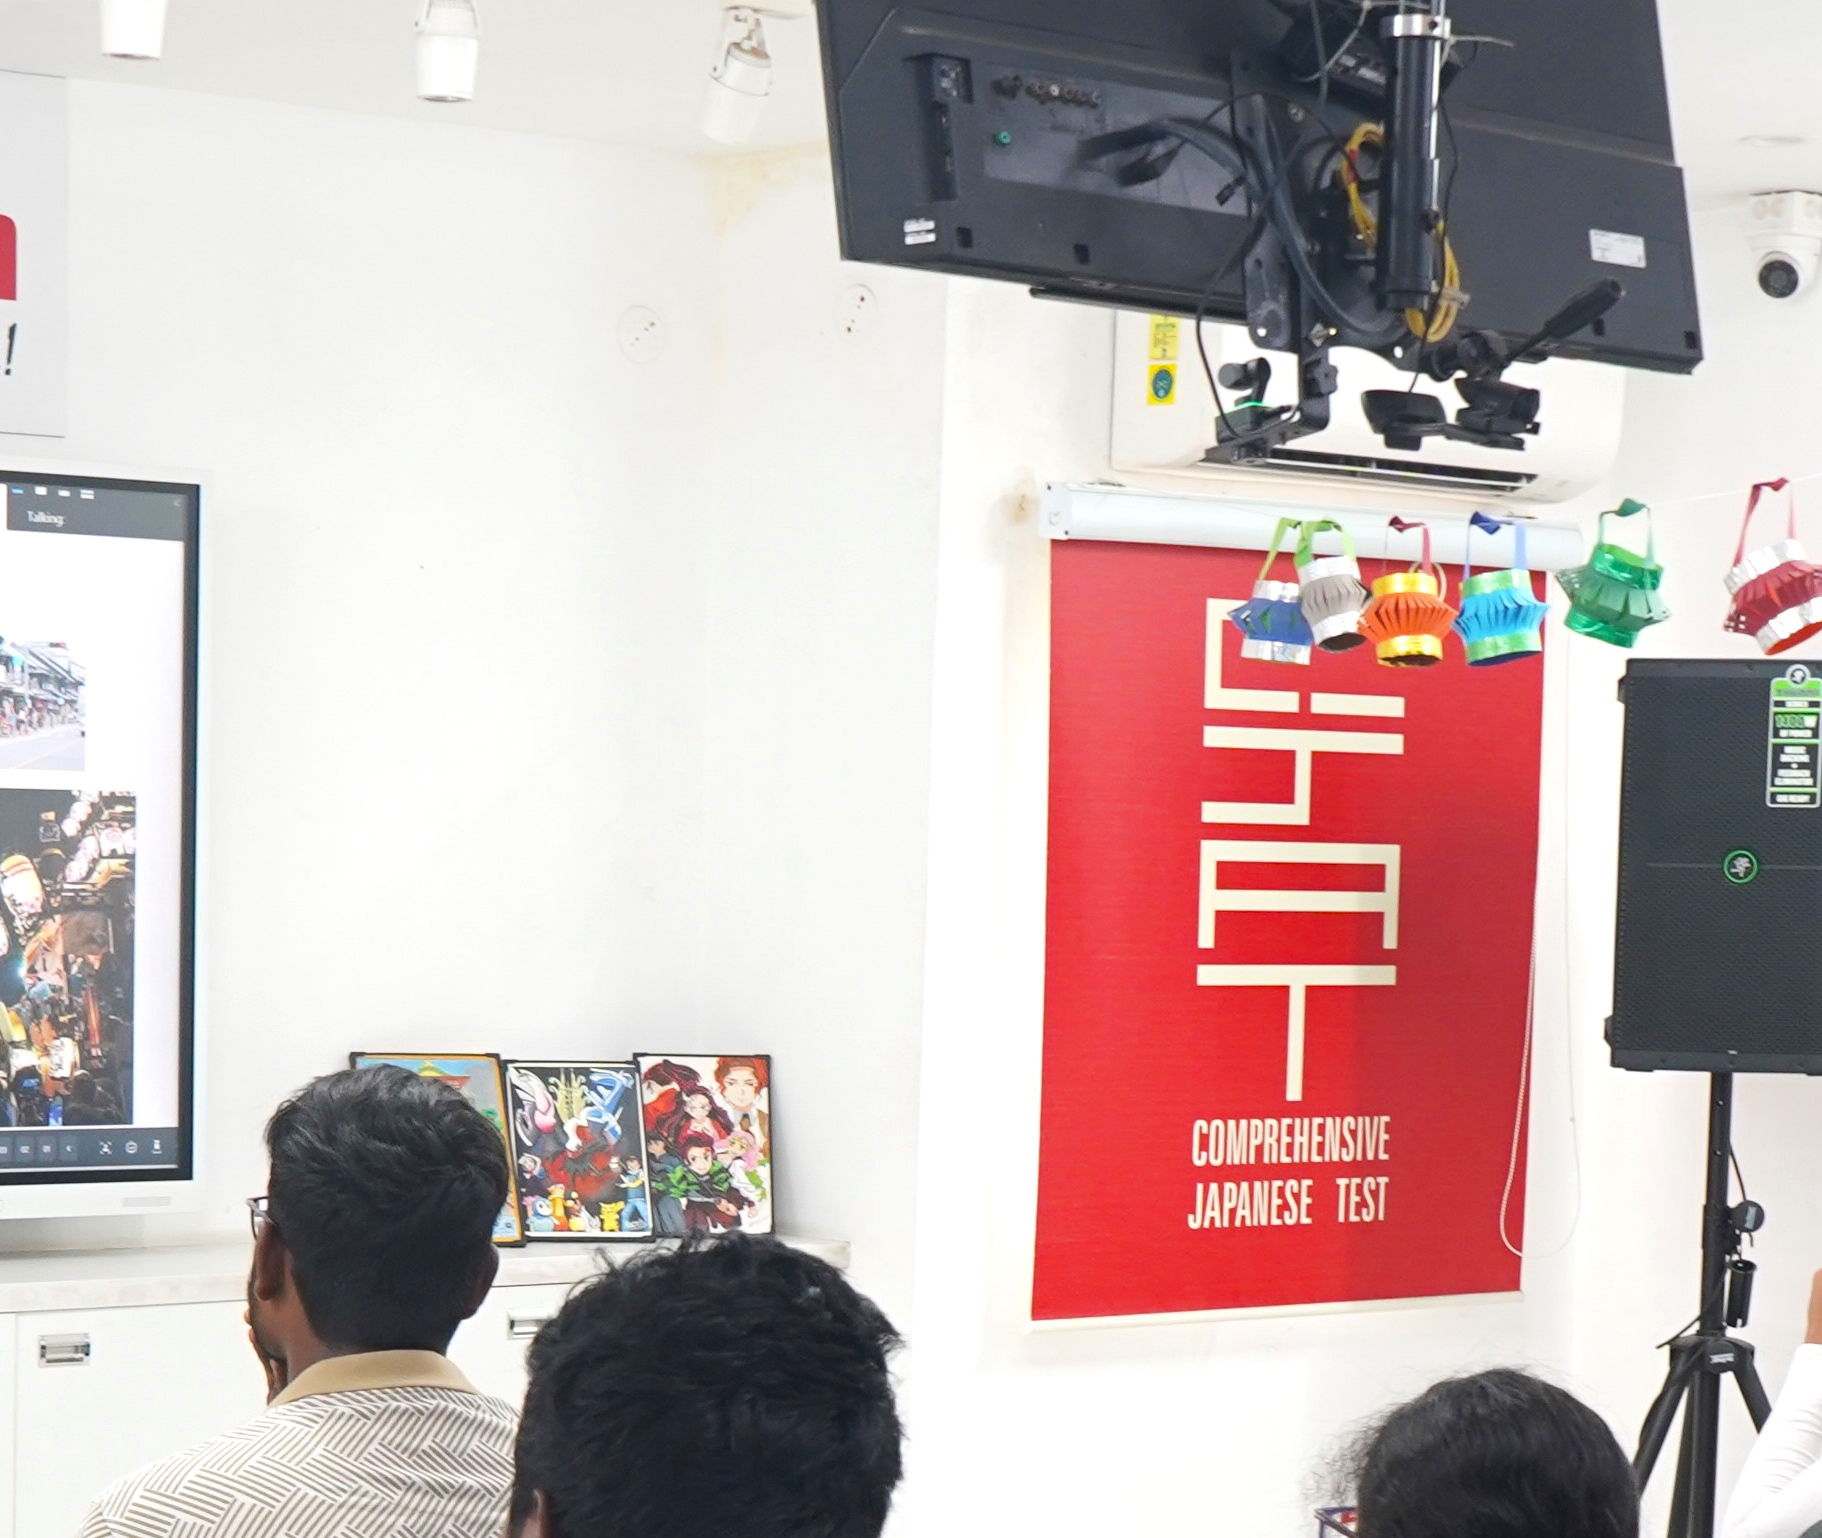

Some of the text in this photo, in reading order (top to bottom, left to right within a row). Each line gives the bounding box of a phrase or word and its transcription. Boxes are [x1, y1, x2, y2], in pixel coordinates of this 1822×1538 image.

[1192, 1115, 1391, 1167] COMPREHENSIVE
[1187, 1176, 1390, 1230] JAPANESE TEST
